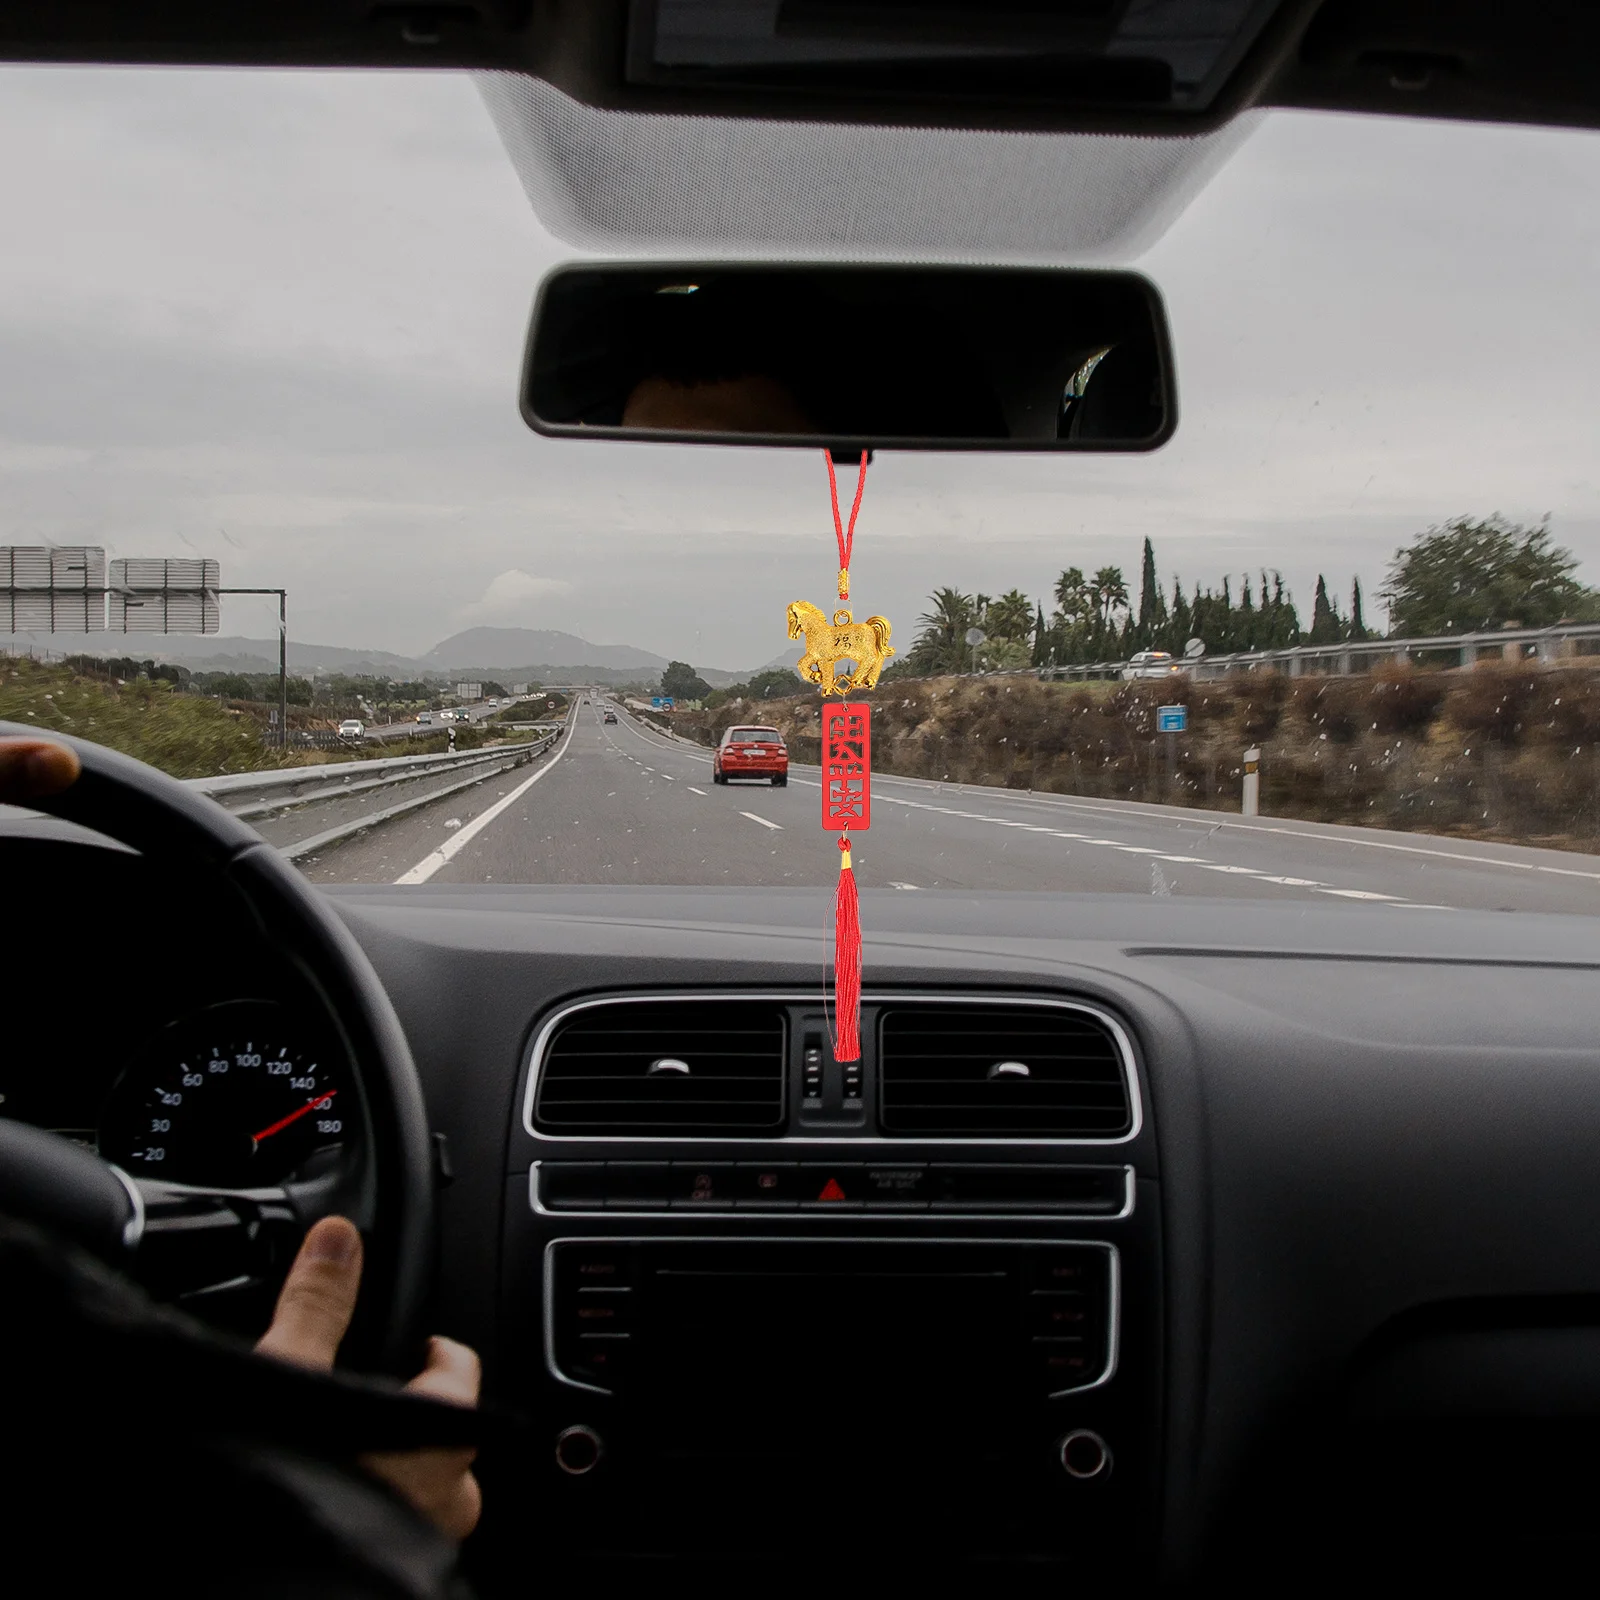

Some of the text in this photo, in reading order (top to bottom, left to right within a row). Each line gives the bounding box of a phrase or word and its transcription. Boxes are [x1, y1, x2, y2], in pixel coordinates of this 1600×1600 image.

[208, 1060, 229, 1073] 80
[235, 1054, 261, 1067] 100
[266, 1061, 292, 1075] 120
[182, 1074, 203, 1087] 60
[290, 1077, 315, 1090] 140
[161, 1093, 182, 1106] 40
[151, 1119, 171, 1132] 30
[317, 1120, 342, 1133] 180
[144, 1147, 165, 1161] 20
